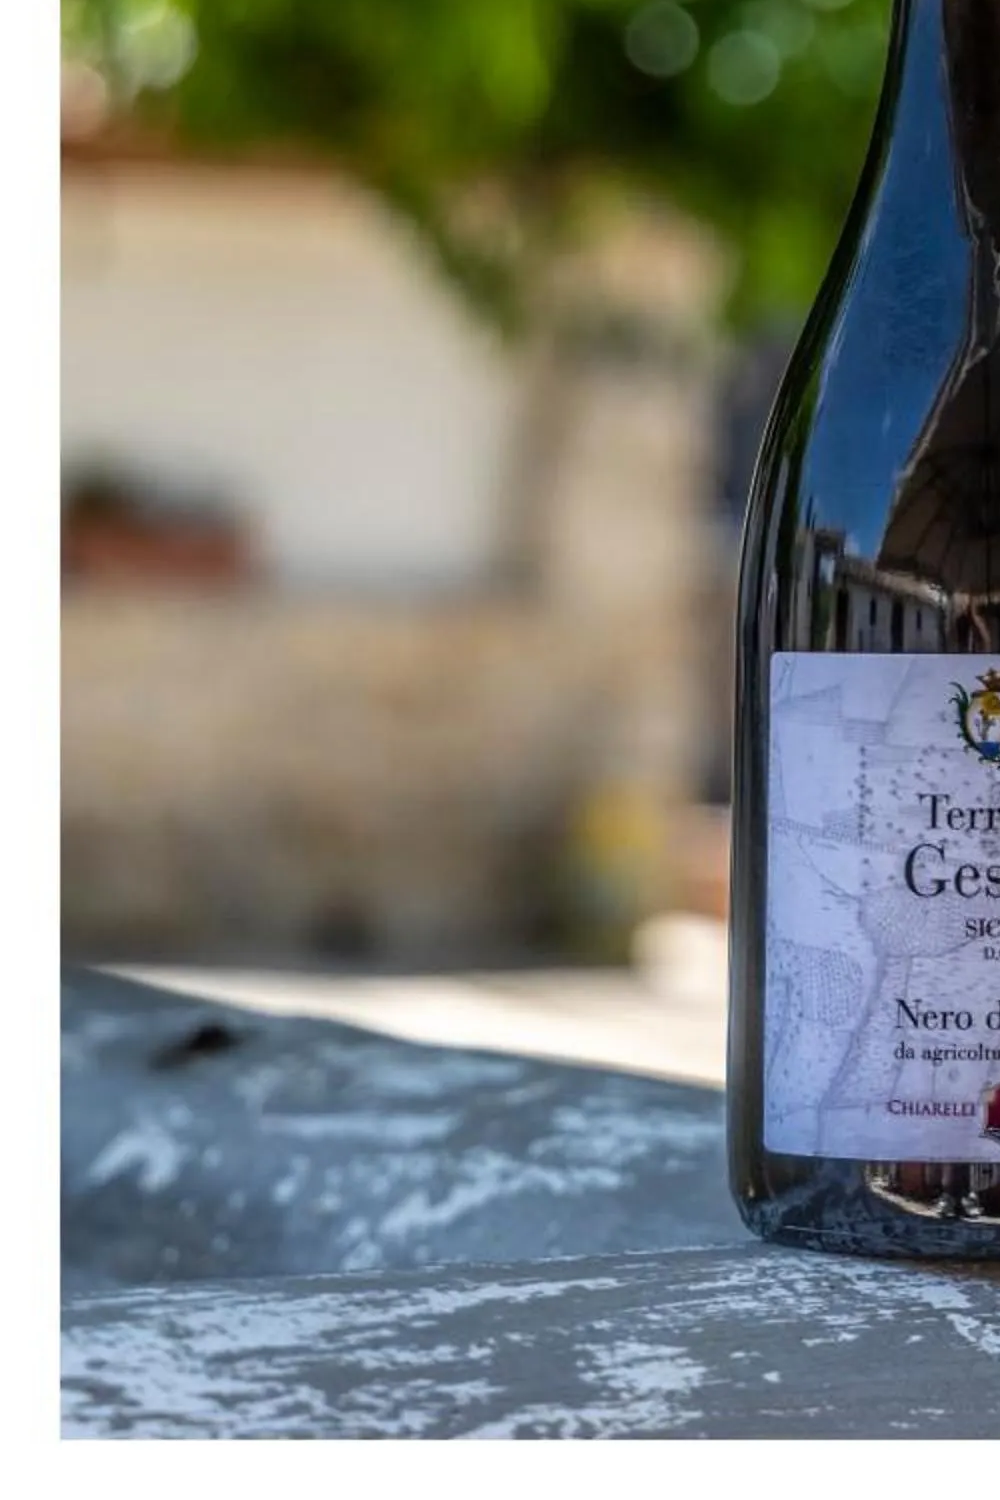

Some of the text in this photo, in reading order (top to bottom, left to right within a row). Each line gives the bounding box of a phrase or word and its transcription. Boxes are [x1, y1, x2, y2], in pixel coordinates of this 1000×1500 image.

[896, 998, 974, 1031] Nero
[893, 1041, 915, 1060] da
[887, 1100, 977, 1117] CHIARELLI
